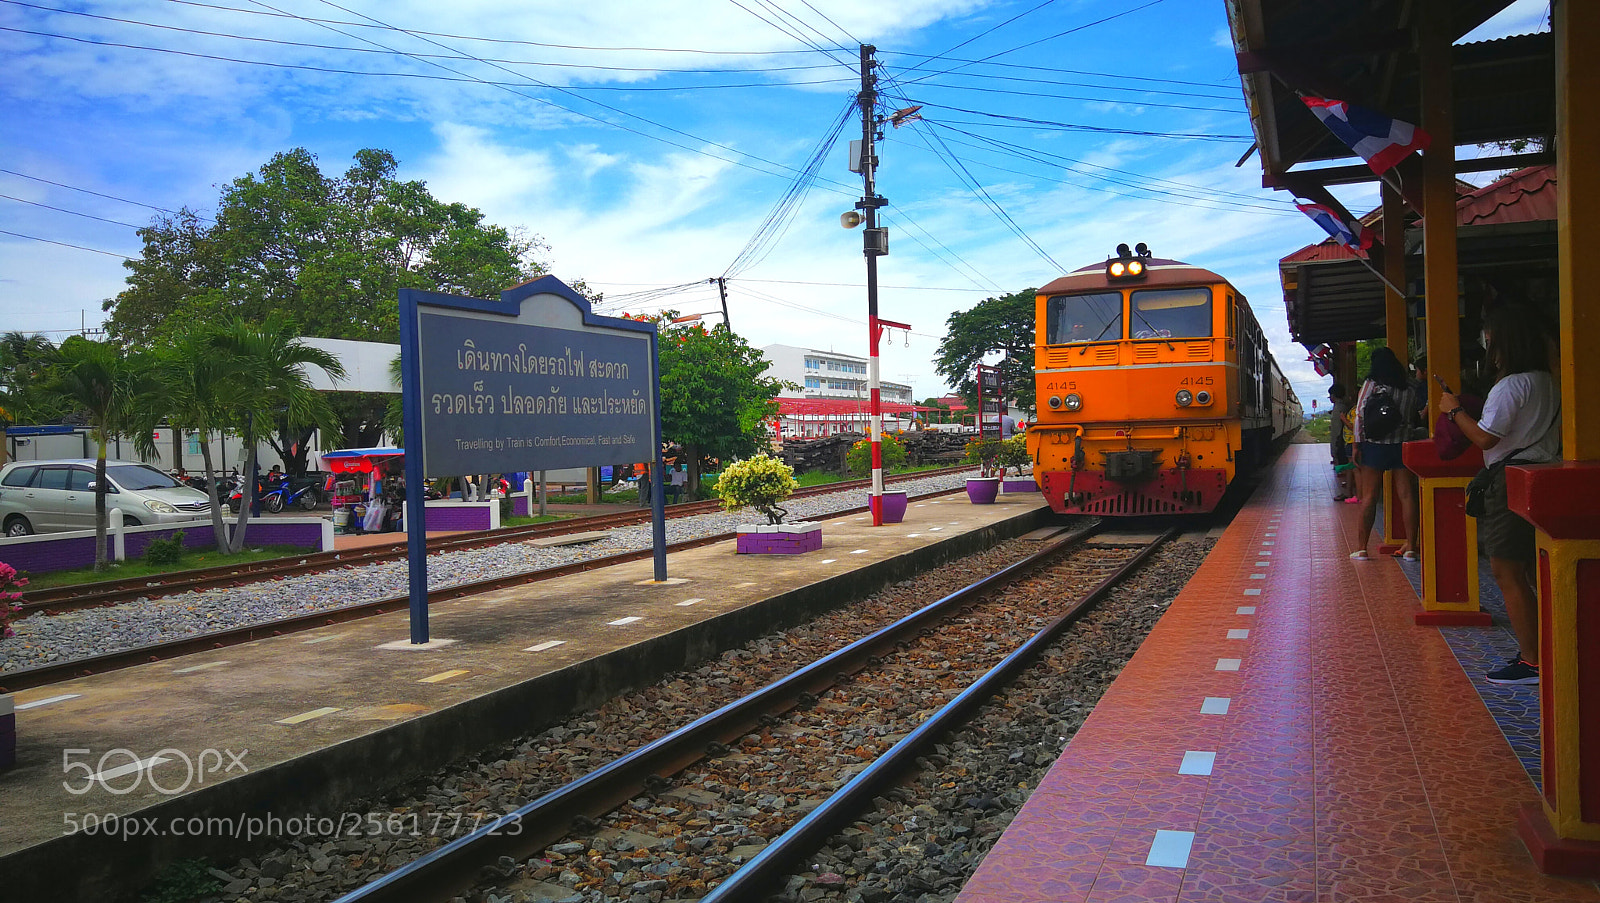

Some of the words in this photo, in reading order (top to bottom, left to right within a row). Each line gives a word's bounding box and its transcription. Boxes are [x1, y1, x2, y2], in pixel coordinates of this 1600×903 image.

[457, 339, 584, 378] เดินทางโดยรถไฟ
[589, 356, 629, 380] สะดวก
[1046, 381, 1077, 391] 4145
[1180, 376, 1214, 386] 4145
[431, 380, 495, 415] รวดเร็ว
[502, 385, 567, 415] ปลอดภัย
[573, 389, 647, 415] และประหยัด
[455, 437, 493, 452] Travelling
[495, 437, 505, 452] by
[506, 436, 524, 448] Train
[526, 437, 532, 447] is
[598, 434, 611, 445] Fast
[611, 435, 621, 444] and
[623, 434, 636, 444] Safe
